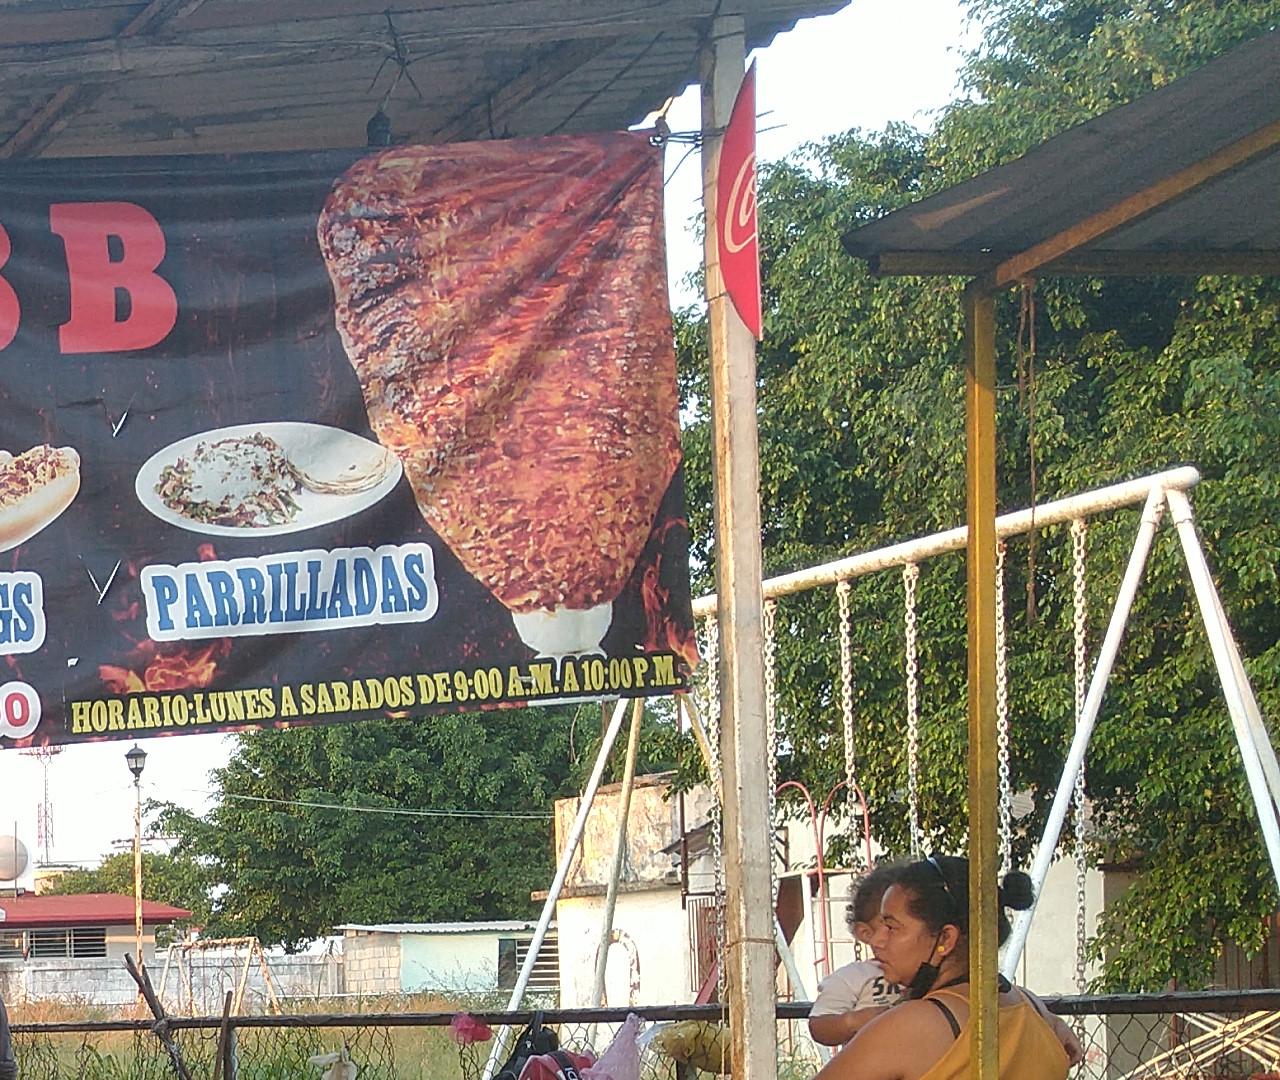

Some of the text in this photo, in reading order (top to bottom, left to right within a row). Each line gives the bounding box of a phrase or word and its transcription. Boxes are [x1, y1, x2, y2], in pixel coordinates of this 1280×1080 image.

[55, 200, 179, 354] B
[151, 553, 429, 632] PARRILLADAS
[280, 687, 298, 715] A
[301, 674, 416, 714] SABADOS
[419, 673, 452, 706] DE
[453, 668, 503, 702] 9:00
[507, 663, 559, 697] A.M.
[564, 661, 580, 692] A
[582, 658, 632, 691] 10:00
